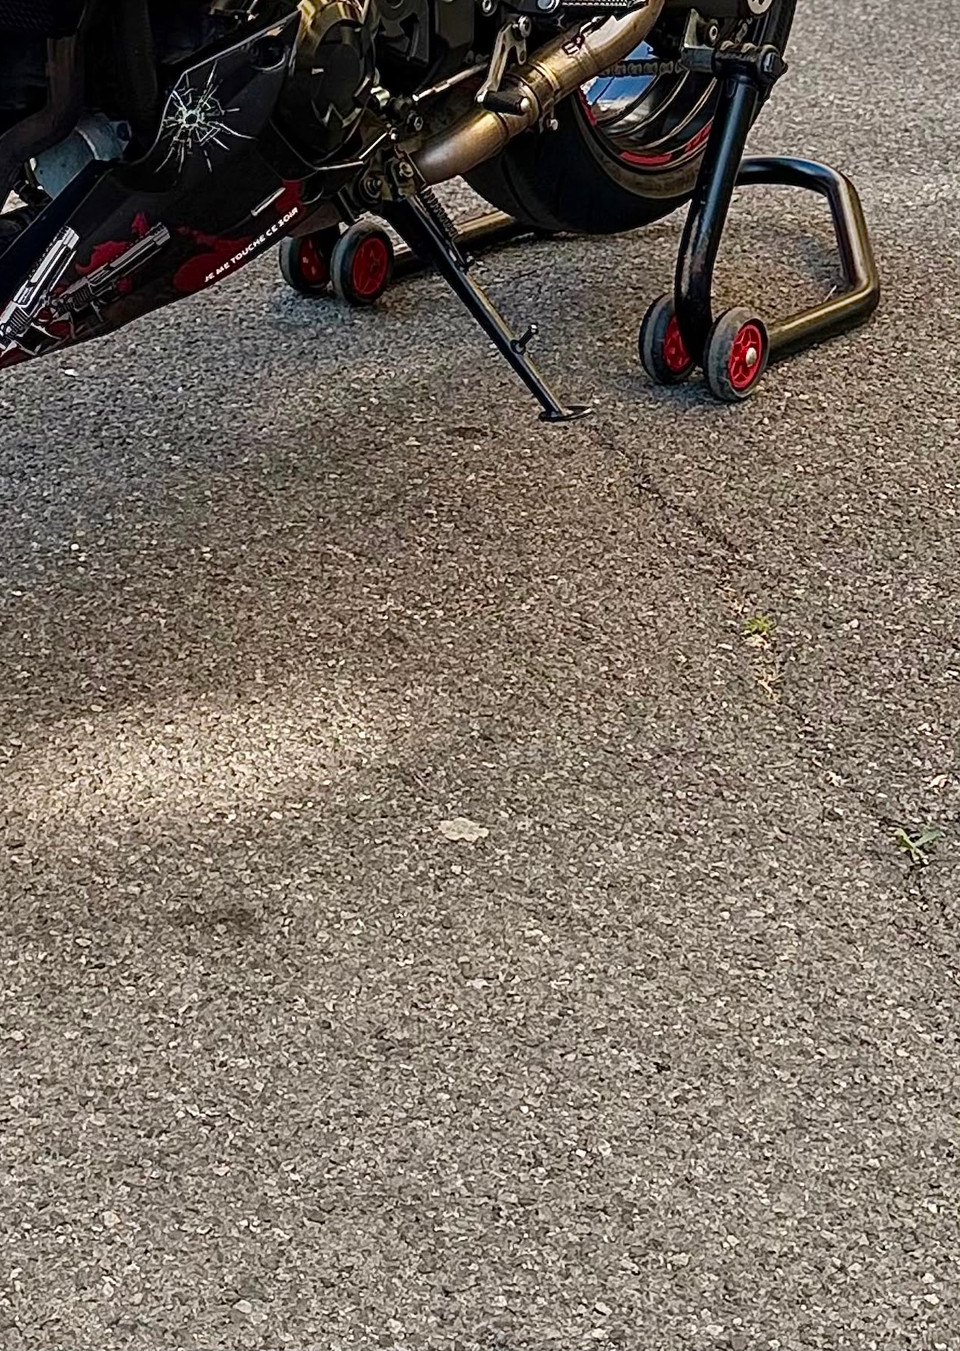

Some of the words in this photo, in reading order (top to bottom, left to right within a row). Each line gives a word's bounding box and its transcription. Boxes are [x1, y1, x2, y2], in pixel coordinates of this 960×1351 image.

[204, 272, 215, 283] JE
[216, 262, 230, 275] ME
[230, 234, 266, 264] TOUCHE
[265, 224, 279, 236] CE
[277, 206, 299, 227] SOIR
